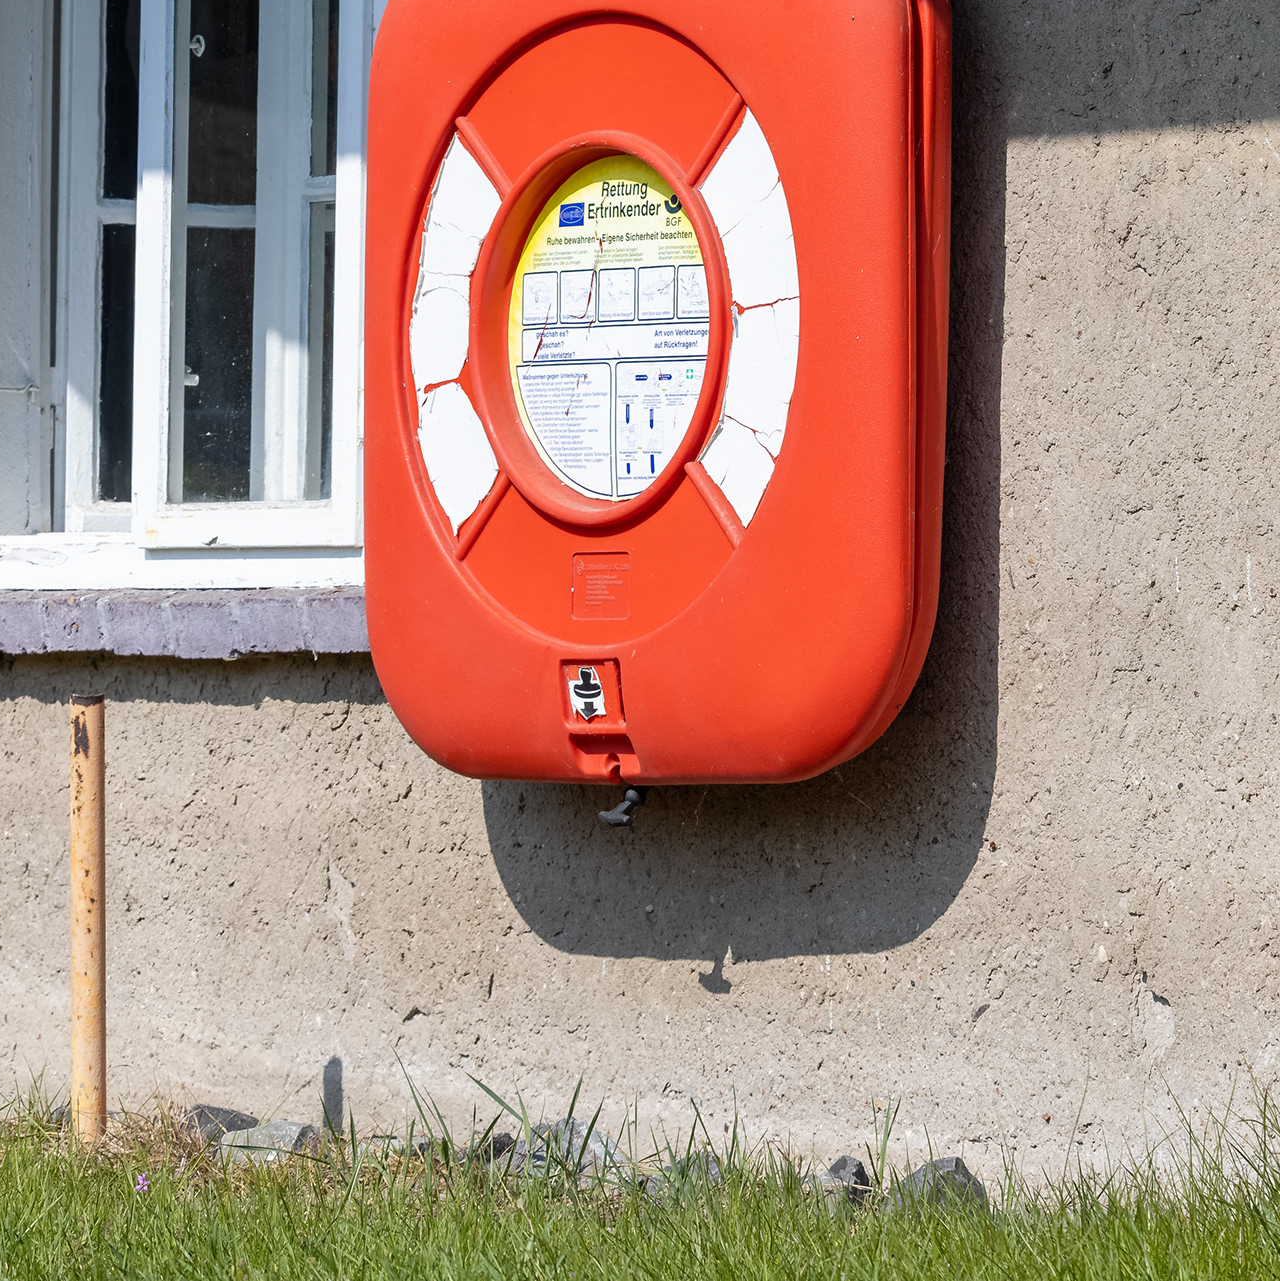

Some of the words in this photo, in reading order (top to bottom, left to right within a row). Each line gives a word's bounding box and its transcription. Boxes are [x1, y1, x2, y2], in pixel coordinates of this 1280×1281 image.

[601, 181, 648, 199] Rettung
[588, 200, 661, 219] Ertrinkender
[665, 216, 682, 227] BGF
[546, 236, 563, 246] Ruhe
[564, 235, 596, 246] bewahren
[602, 233, 624, 245] Eigene
[625, 231, 659, 242] Sicherheit
[660, 230, 693, 240] beachten
[654, 329, 663, 337] Art
